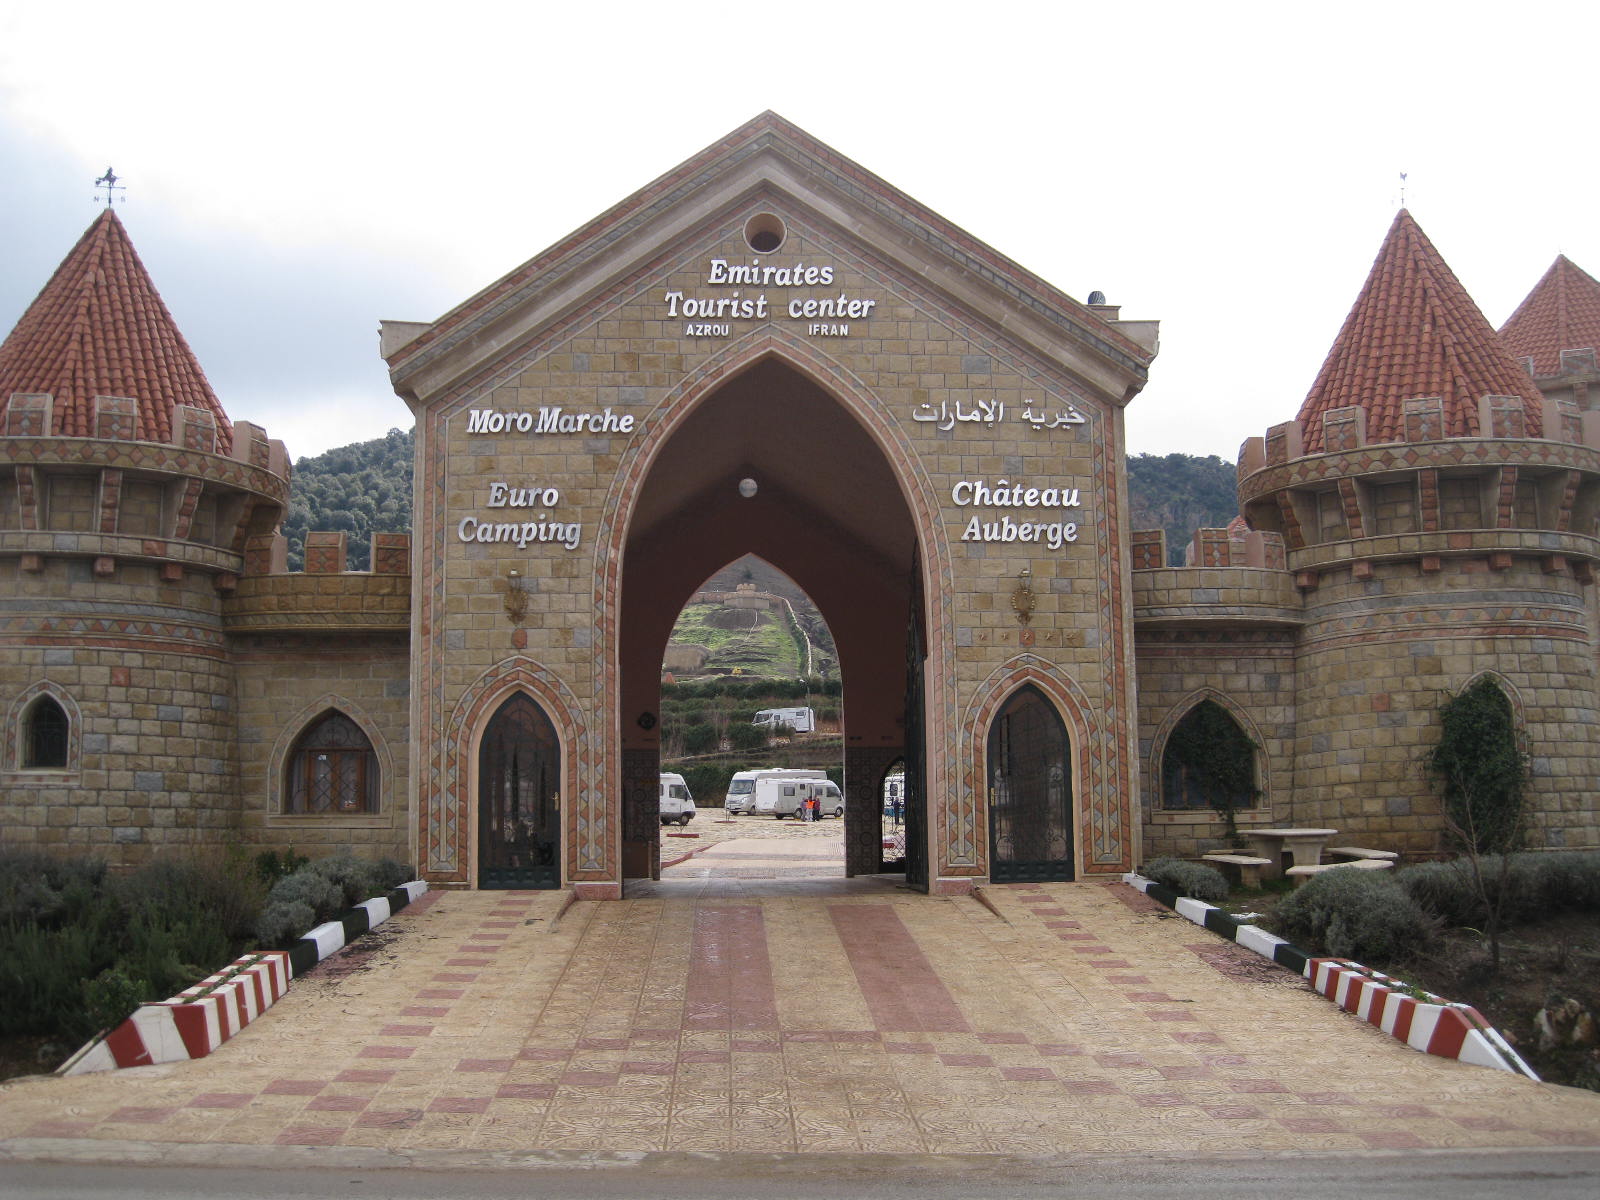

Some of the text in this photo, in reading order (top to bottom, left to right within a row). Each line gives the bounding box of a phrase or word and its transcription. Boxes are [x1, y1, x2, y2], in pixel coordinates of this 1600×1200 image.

[708, 259, 834, 286] Emirates
[665, 291, 876, 318] Tourist center
[686, 324, 849, 336] AZROU IFRAN
[467, 407, 634, 433] Moro Marche
[1021, 398, 1086, 430] خيرية
[487, 482, 559, 507] Euro
[951, 479, 1081, 507] Château
[458, 514, 582, 550] Camping
[961, 515, 1078, 550] Auberge
